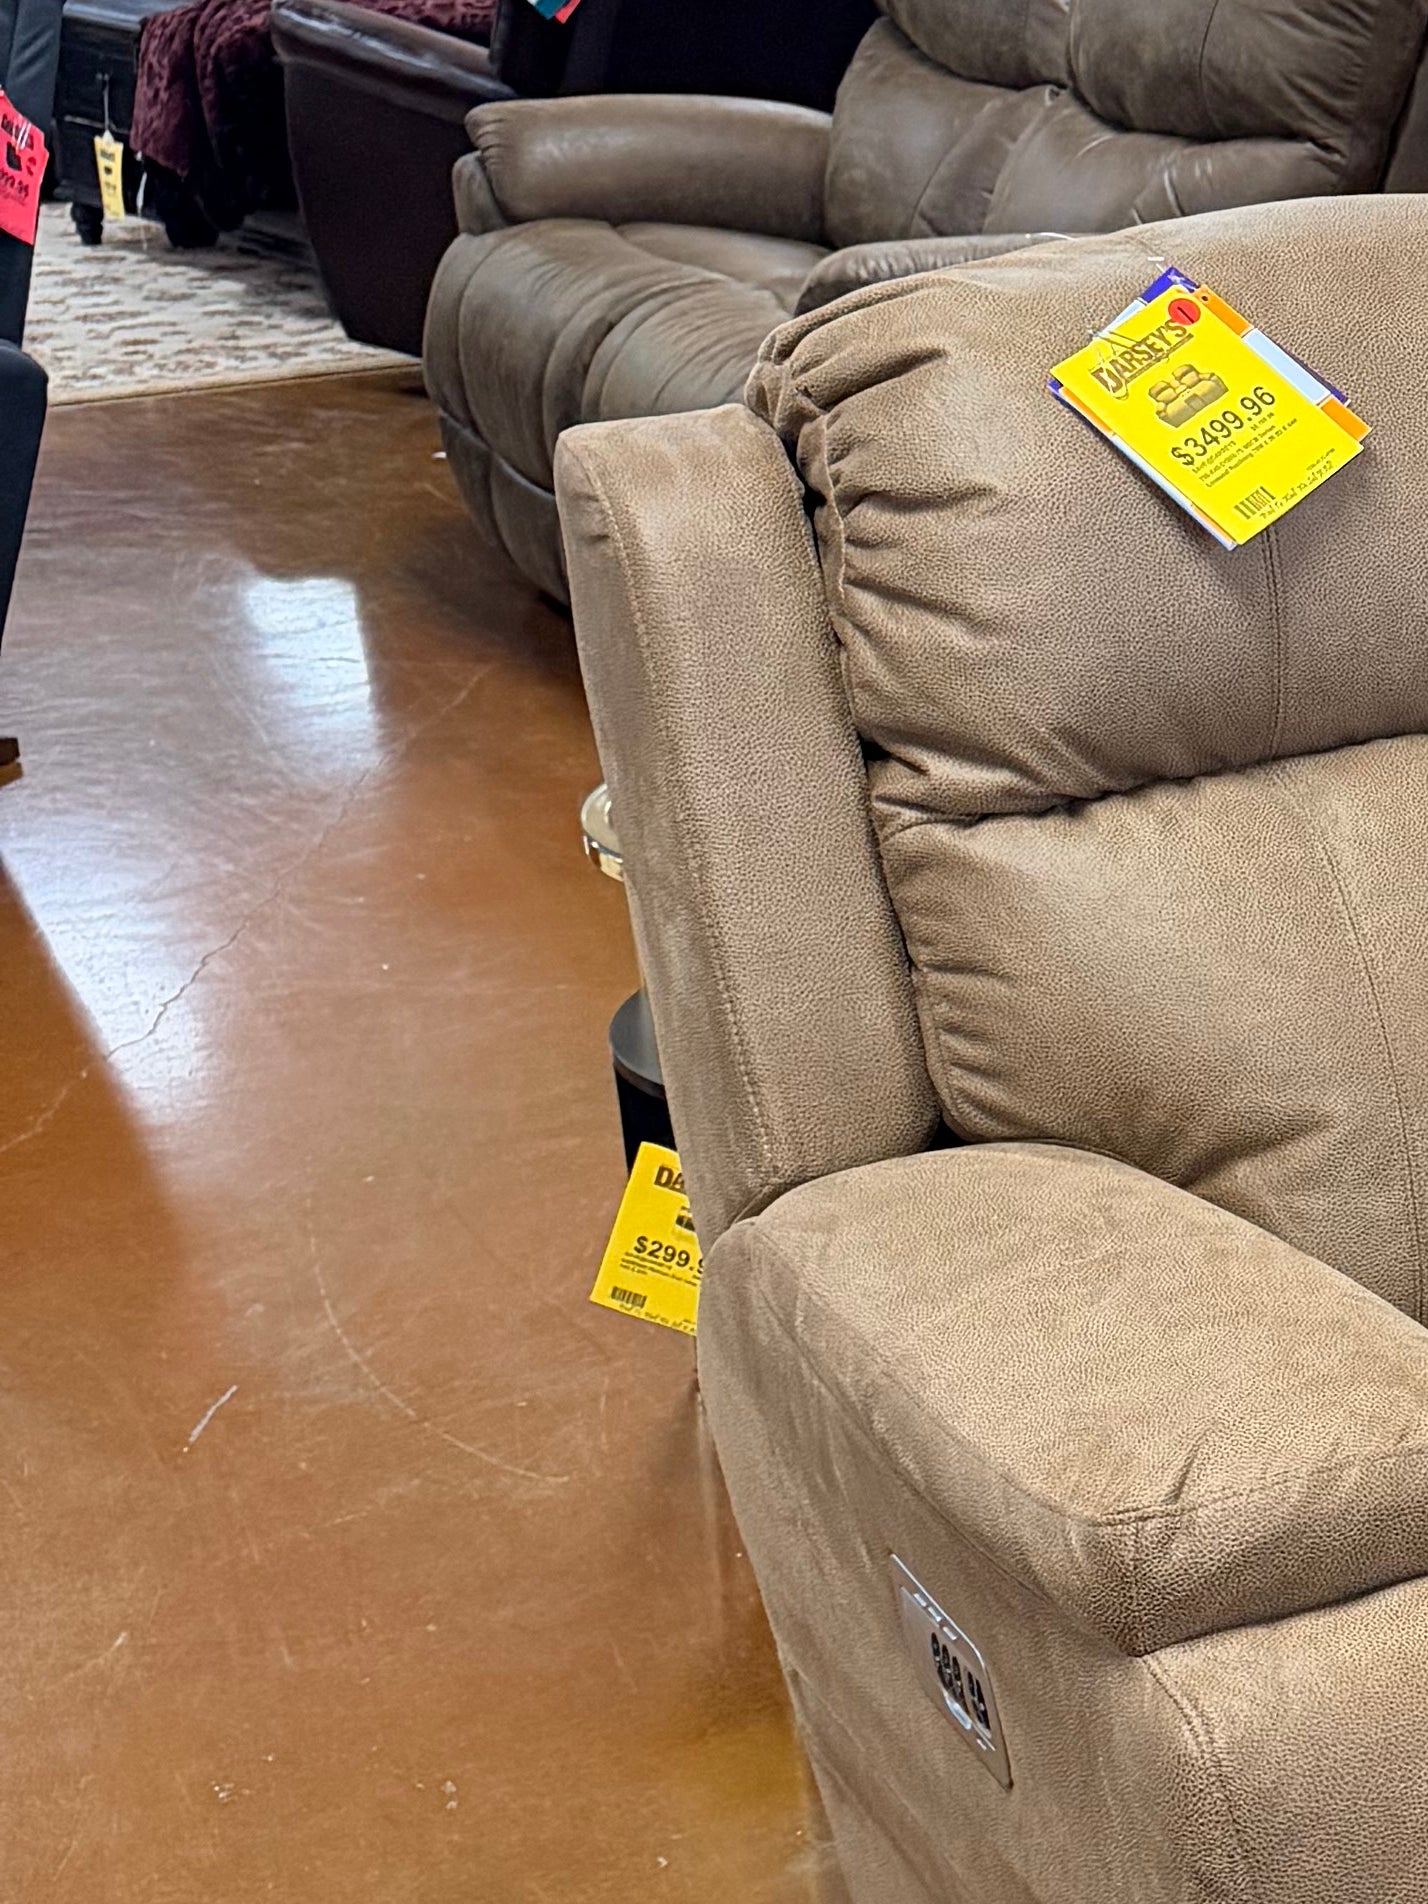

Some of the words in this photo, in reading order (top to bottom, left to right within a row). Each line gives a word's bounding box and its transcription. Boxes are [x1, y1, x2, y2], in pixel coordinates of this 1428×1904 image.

[1090, 319, 1188, 394] DARSEY'S
[1171, 386, 1276, 466] $3499.96
[654, 1165, 685, 1190] DA
[633, 1235, 704, 1274] $299.9
